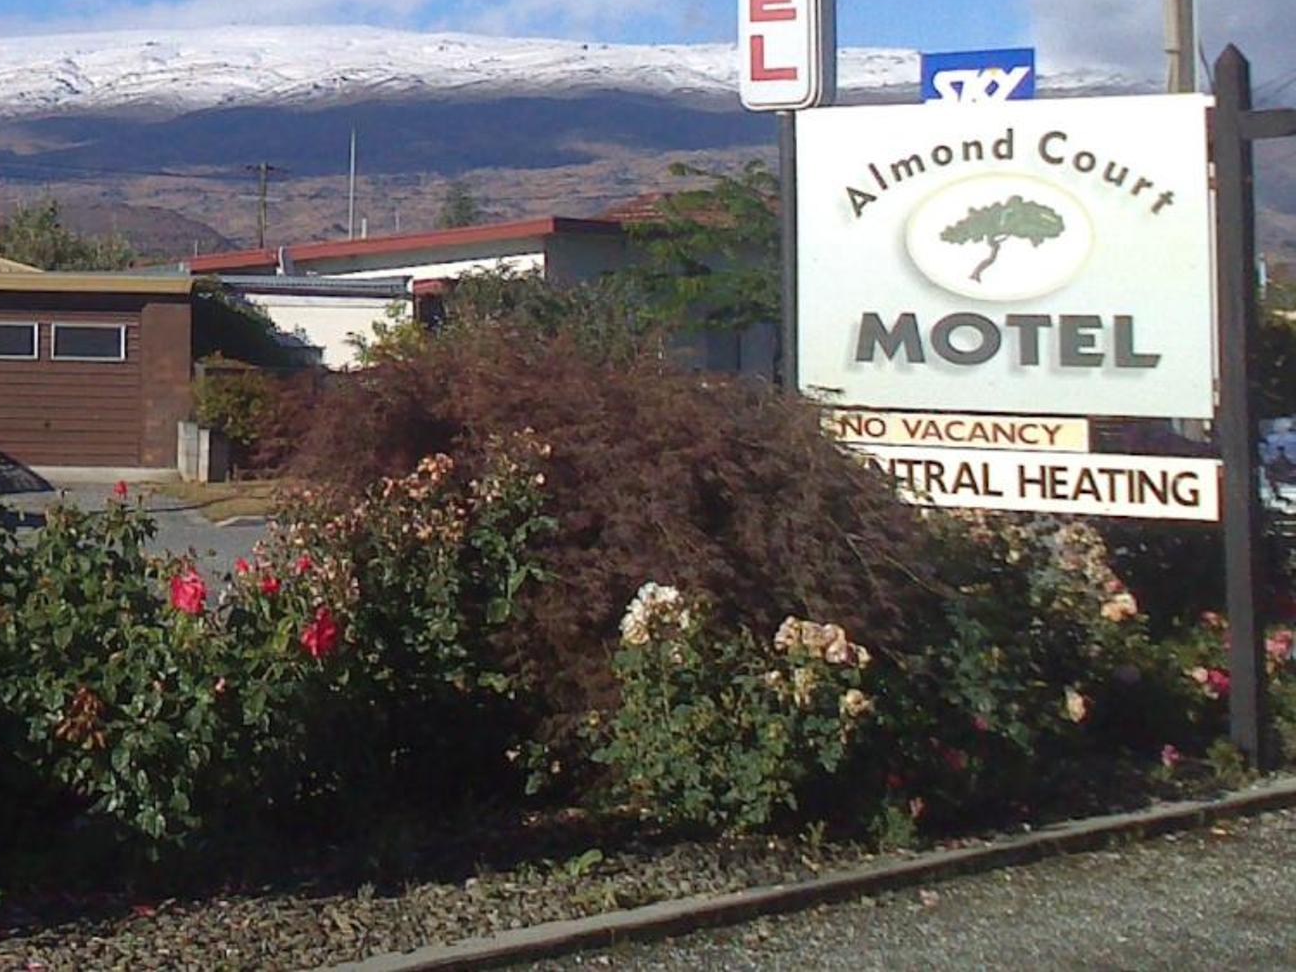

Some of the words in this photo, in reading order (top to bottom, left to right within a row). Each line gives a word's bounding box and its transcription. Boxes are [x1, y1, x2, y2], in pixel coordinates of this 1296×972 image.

[933, 67, 1030, 102] SKY
[845, 128, 1014, 218] Almond
[1038, 130, 1175, 216] Court
[855, 312, 1162, 369] MOTEL
[840, 413, 886, 438] NO
[901, 419, 1063, 446] VACANCY
[868, 458, 1004, 497] NTRAL
[1018, 465, 1201, 507] HEATING
